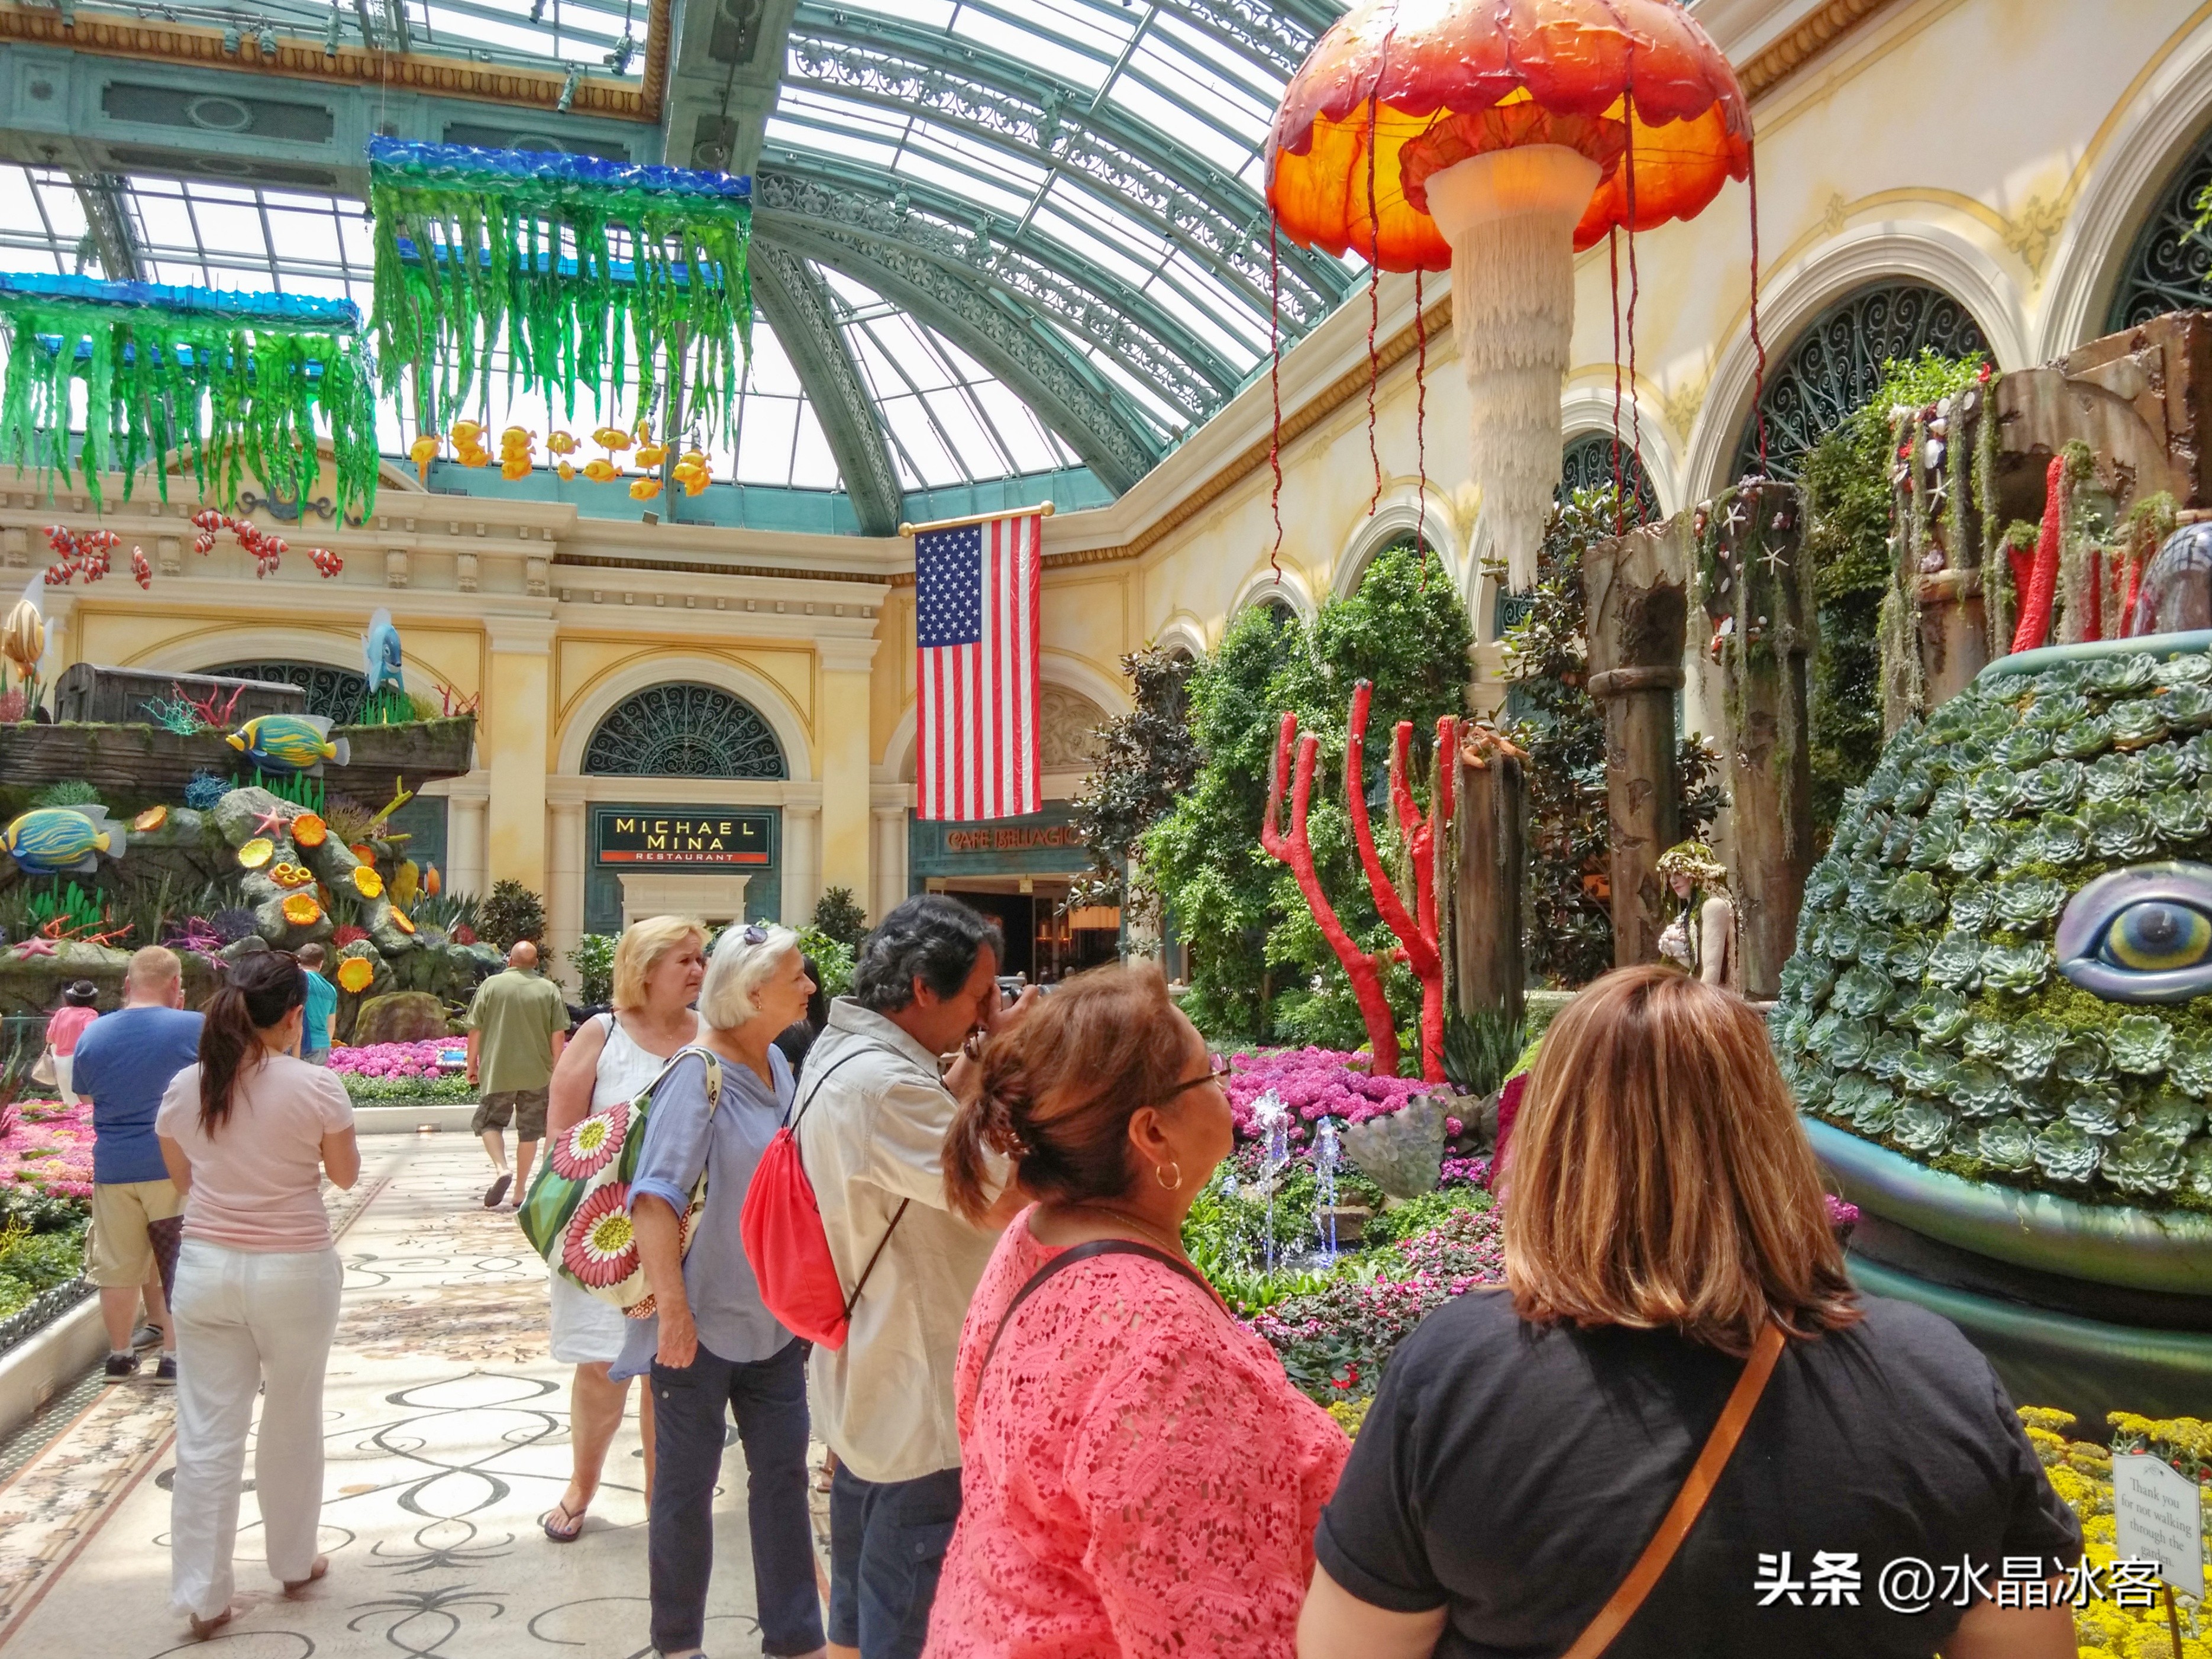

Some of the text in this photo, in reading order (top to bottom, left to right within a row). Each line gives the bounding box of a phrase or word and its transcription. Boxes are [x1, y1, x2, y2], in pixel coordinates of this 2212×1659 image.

[616, 818, 754, 835] MICHAEL
[647, 834, 724, 850] MINA
[635, 853, 734, 861] RESTAURANT
[2130, 1477, 2180, 1509] Thank you
[2121, 1493, 2192, 1538] for not walking
[2130, 1518, 2185, 1552] through the
[2140, 1545, 2175, 1568] garden.
